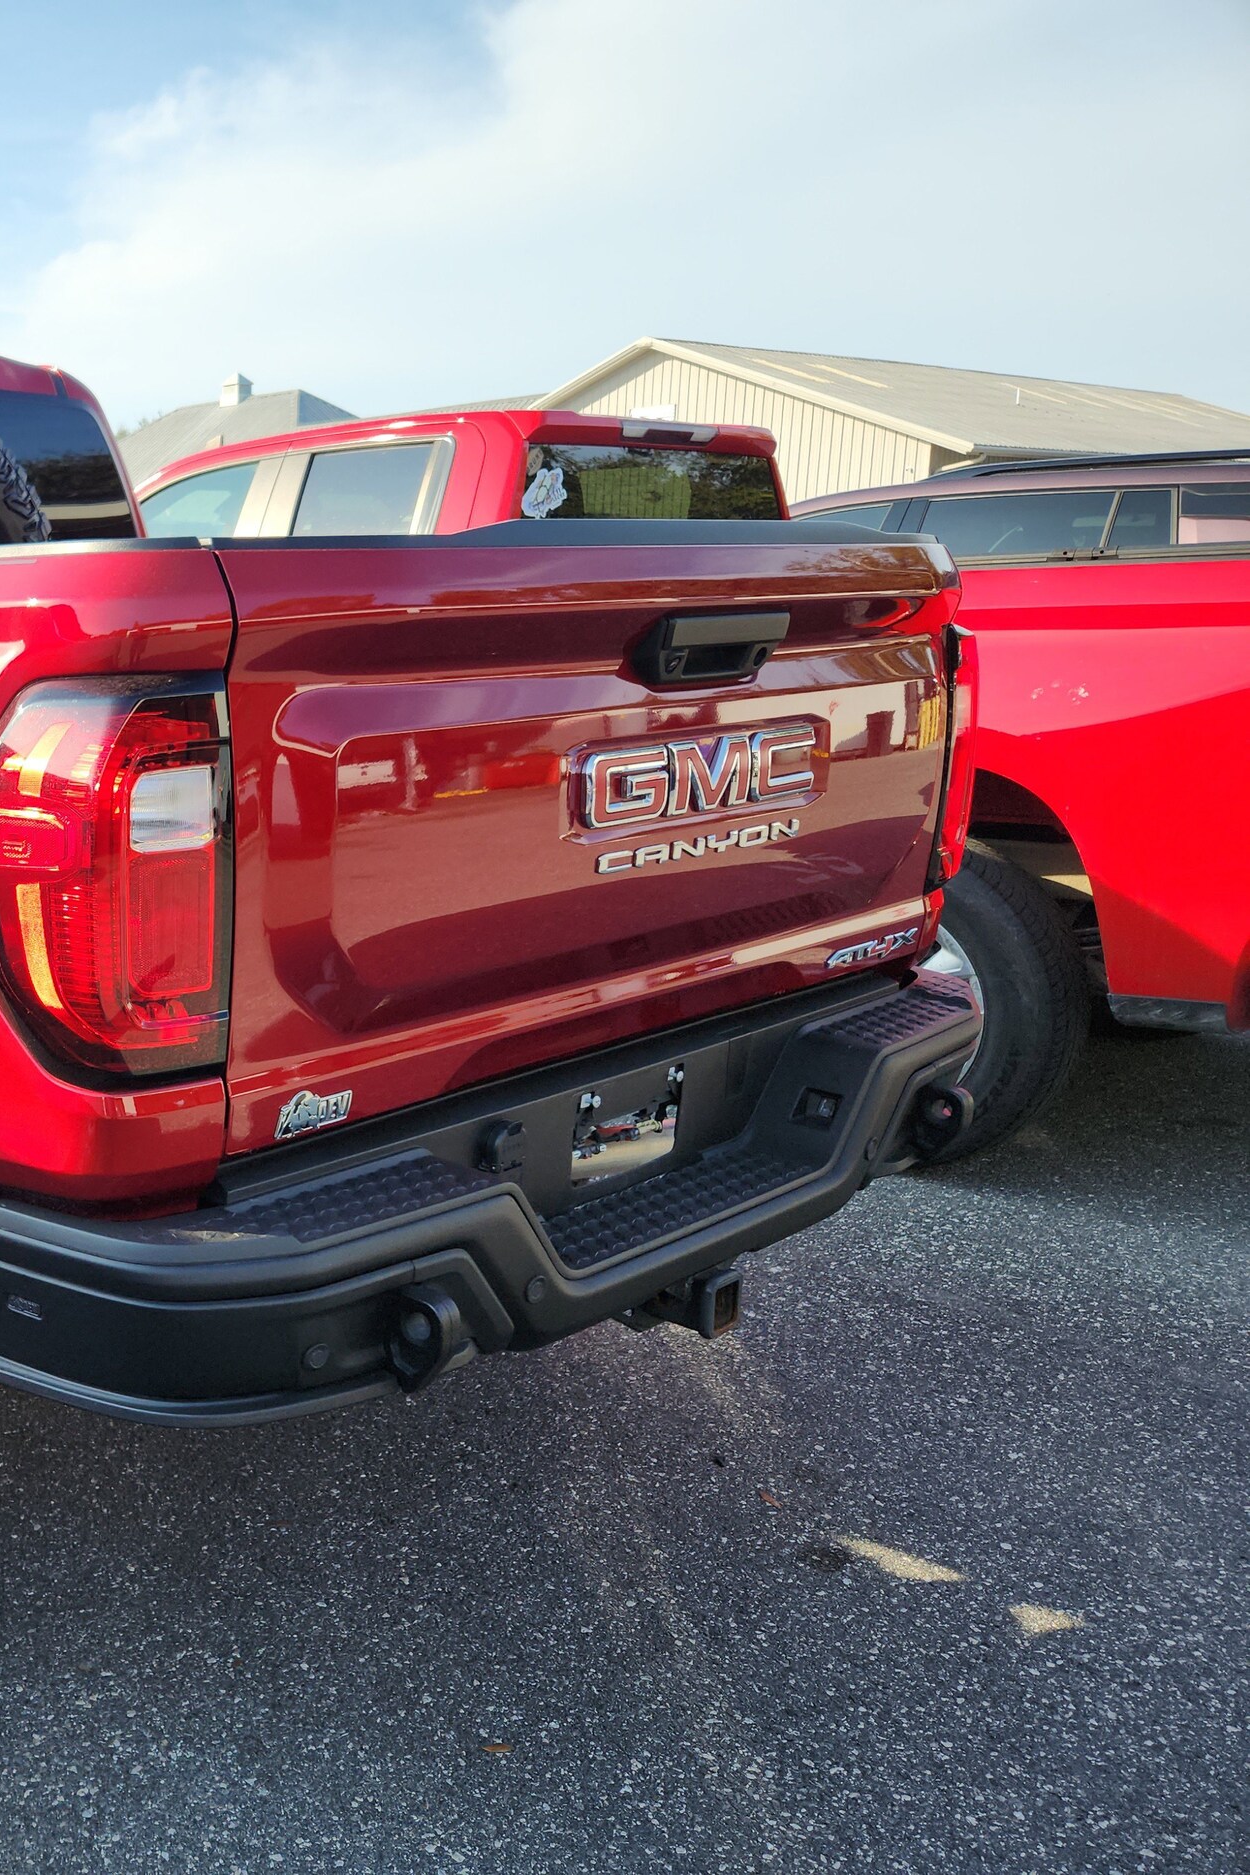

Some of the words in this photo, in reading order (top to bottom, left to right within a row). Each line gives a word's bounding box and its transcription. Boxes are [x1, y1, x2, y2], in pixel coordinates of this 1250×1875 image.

[584, 724, 816, 828] GMC
[597, 818, 800, 874] CANYON
[824, 927, 918, 969] AT4X
